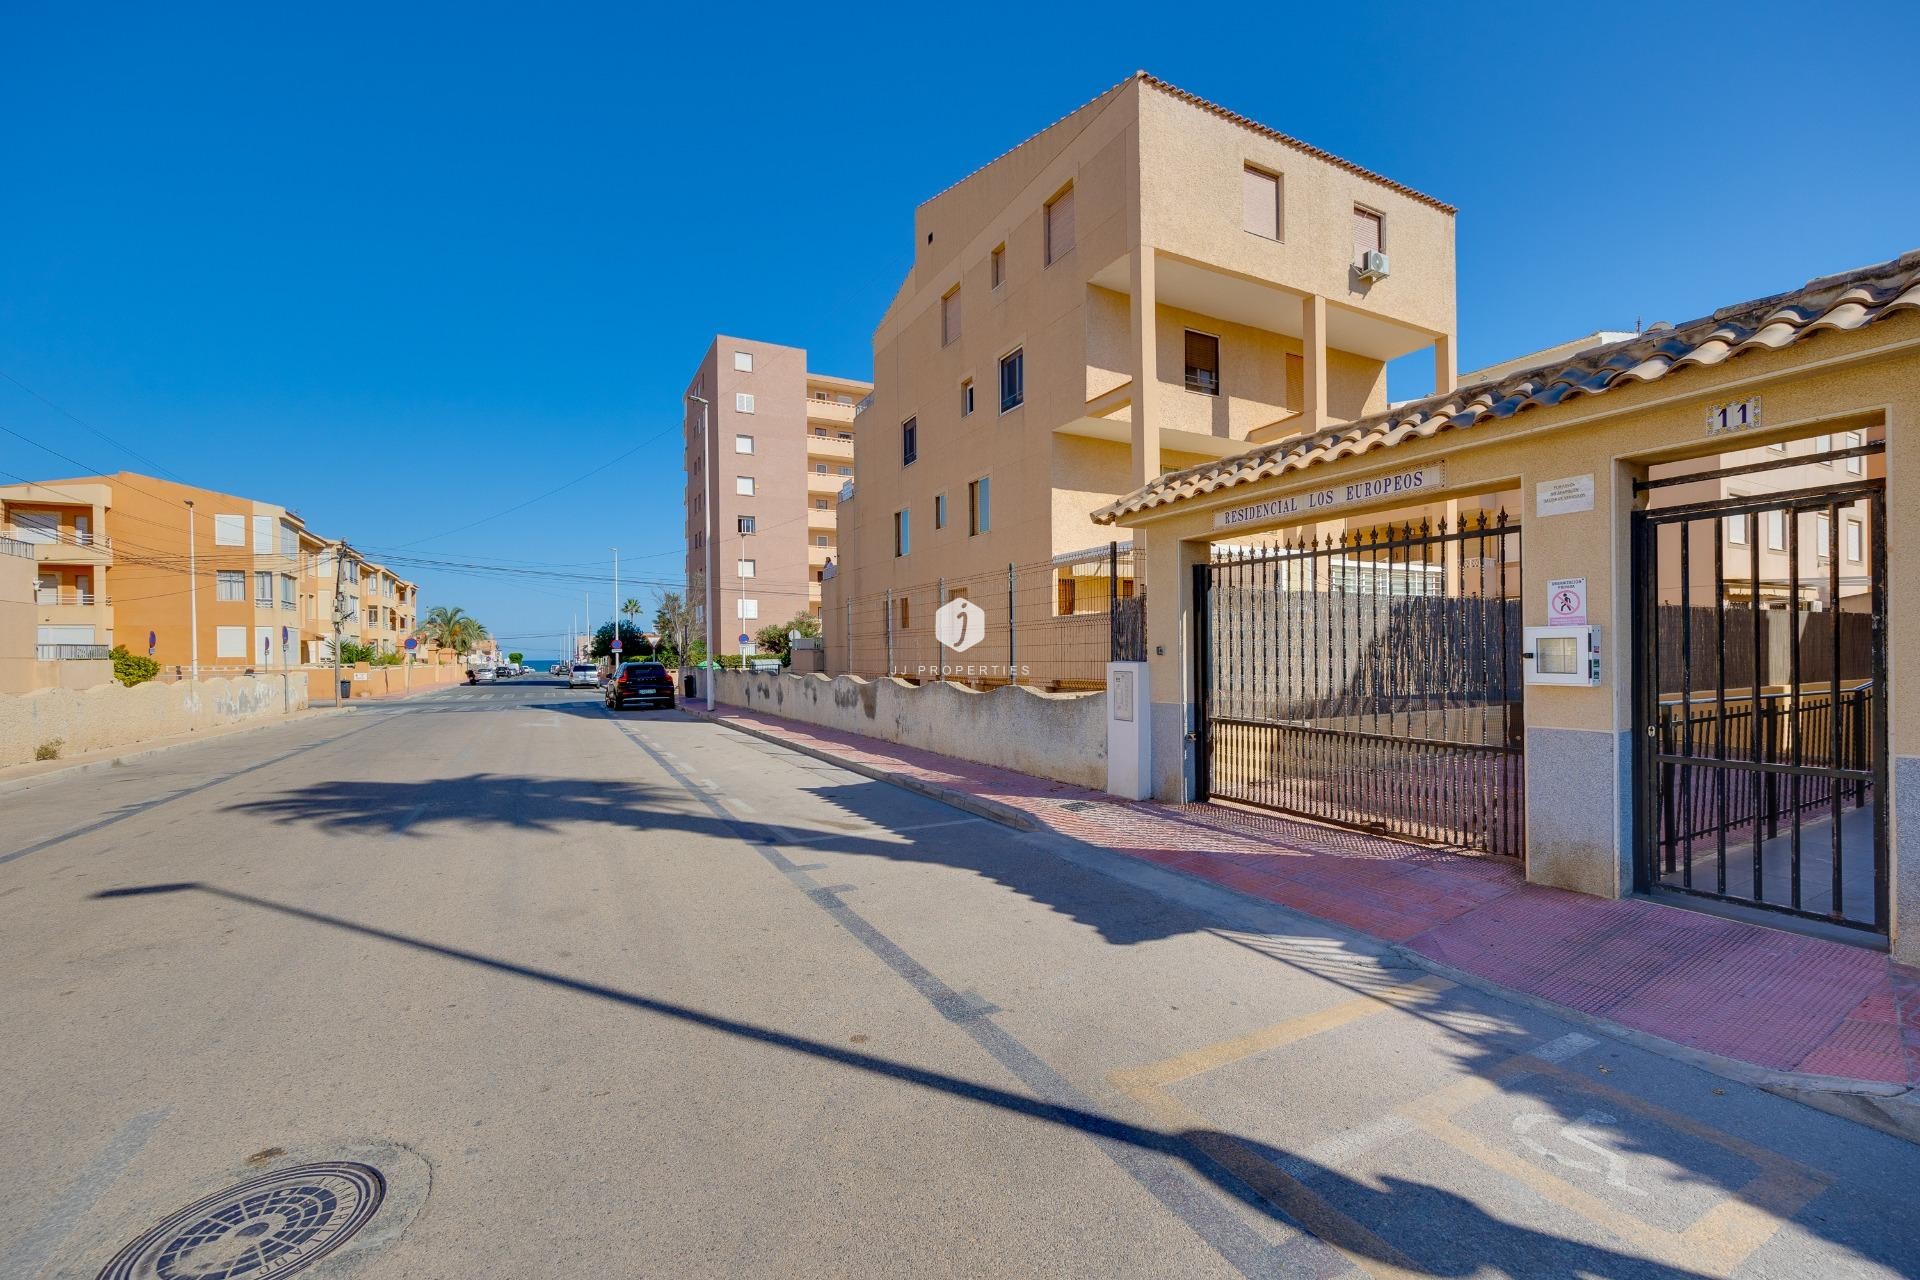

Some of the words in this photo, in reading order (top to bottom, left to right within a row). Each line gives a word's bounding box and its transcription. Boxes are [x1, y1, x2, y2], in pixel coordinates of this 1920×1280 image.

[1718, 404, 1747, 427] 11
[1224, 497, 1298, 525] RESIDENCIAL
[1309, 489, 1335, 508] LOS
[1346, 470, 1424, 501] EUROPEOS
